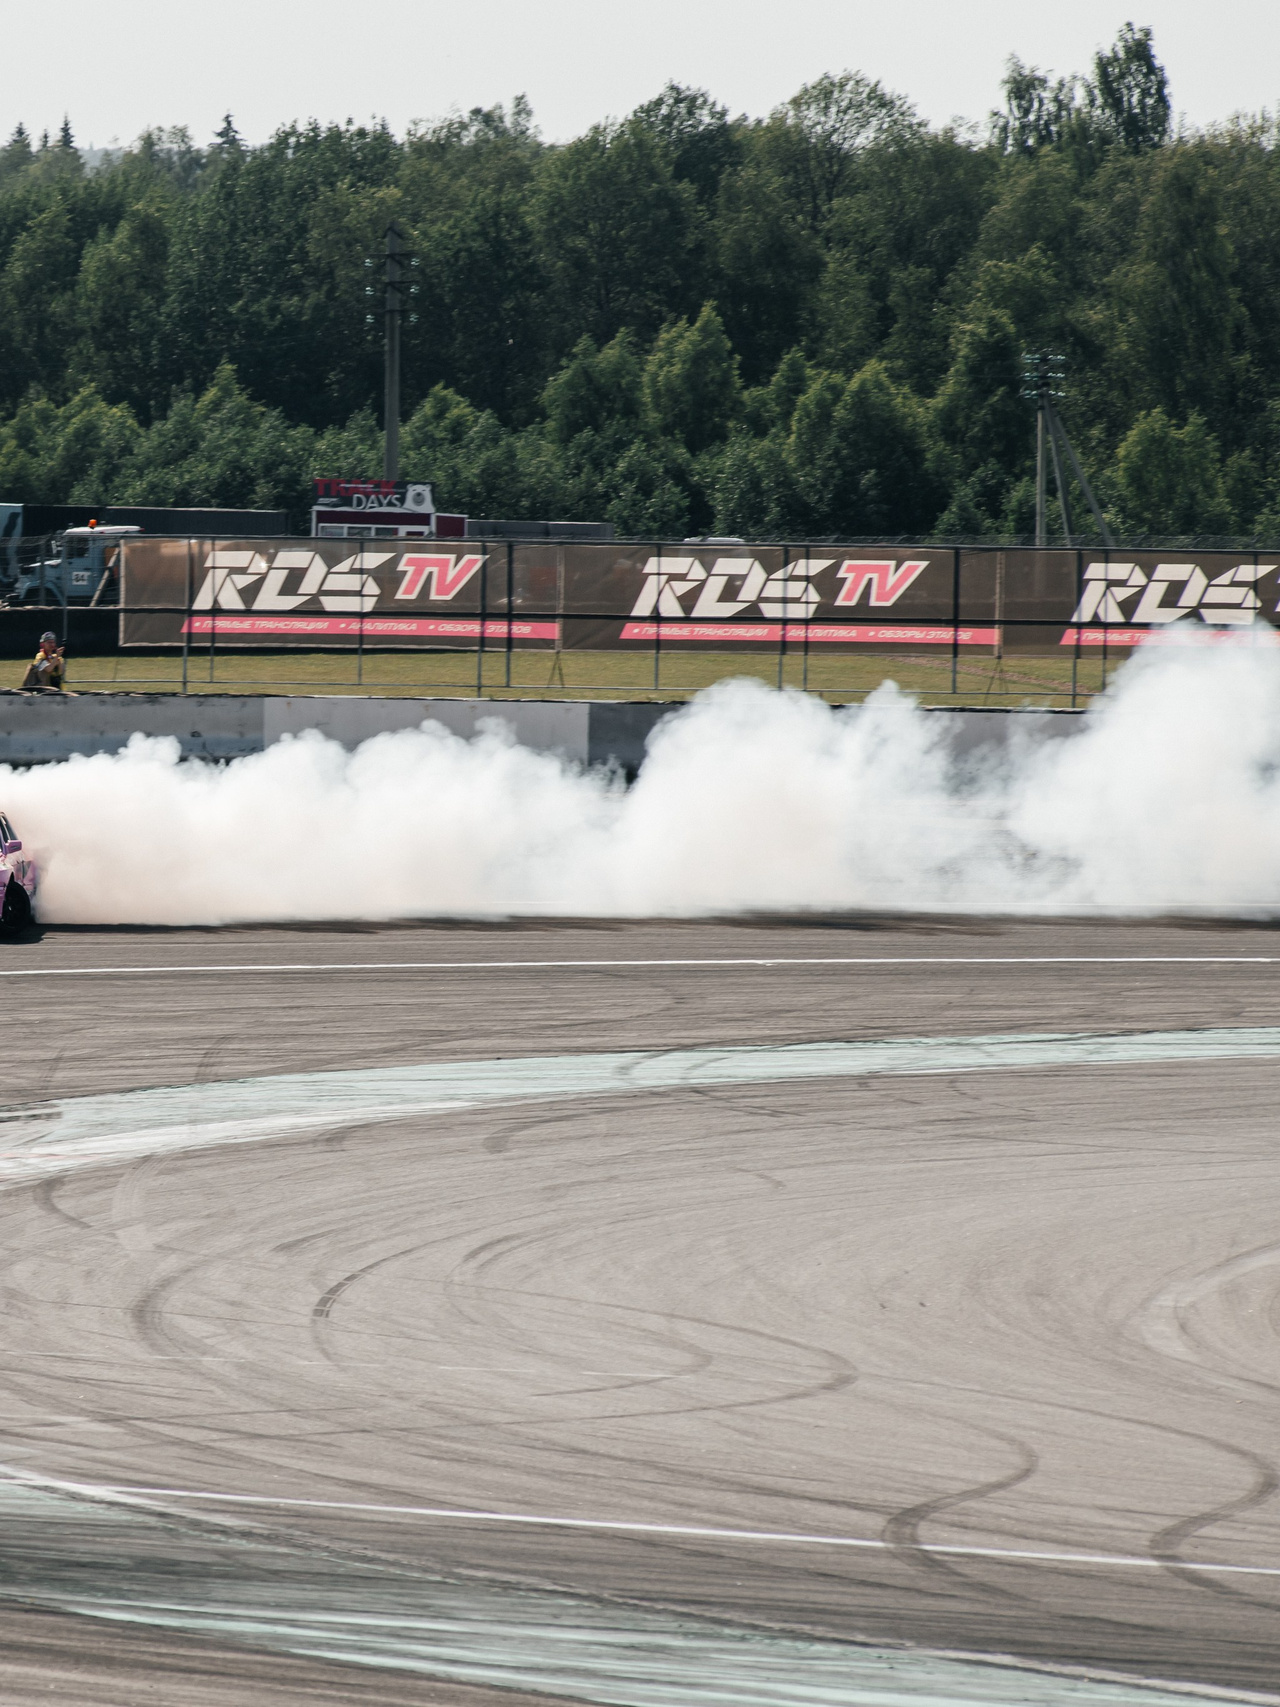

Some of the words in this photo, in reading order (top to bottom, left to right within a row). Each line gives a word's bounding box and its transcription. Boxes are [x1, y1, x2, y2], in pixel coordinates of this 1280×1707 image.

[314, 479, 398, 497] TRACK
[352, 493, 402, 511] DAYS
[192, 551, 397, 613] RDS
[394, 553, 491, 600] TV
[630, 557, 837, 619] RDS
[833, 560, 931, 607] TV
[1071, 563, 1279, 625] RDS
